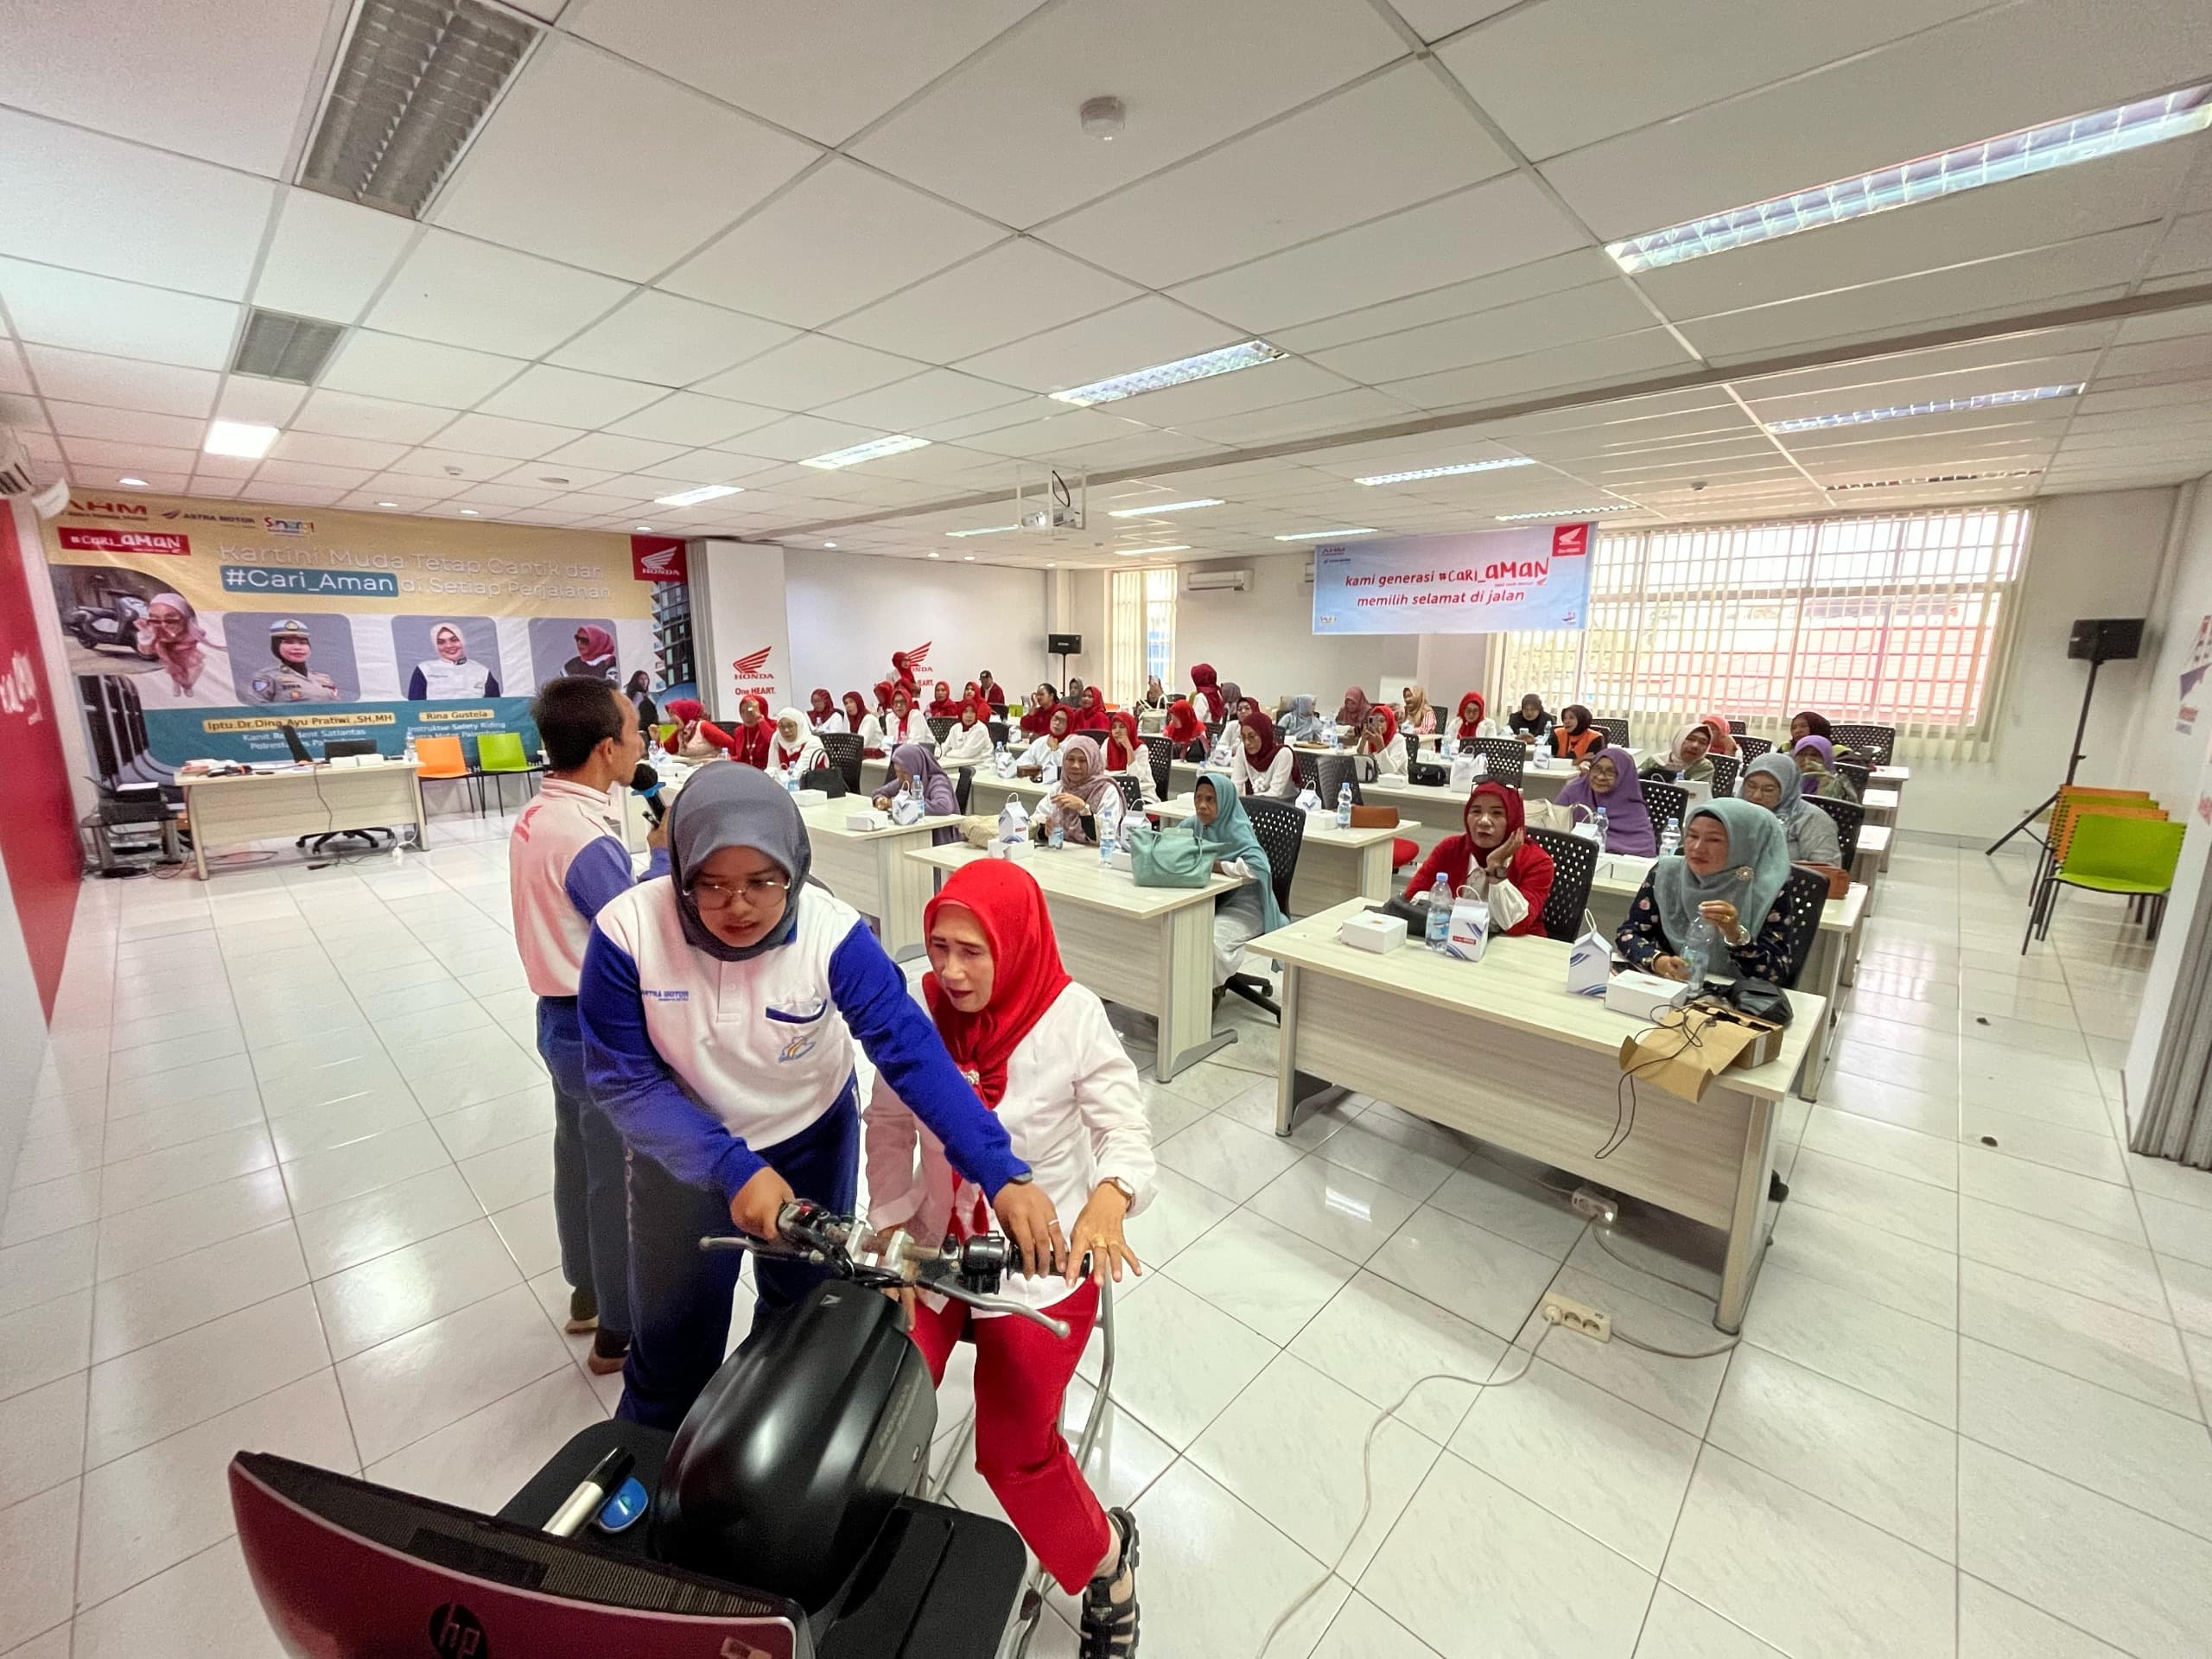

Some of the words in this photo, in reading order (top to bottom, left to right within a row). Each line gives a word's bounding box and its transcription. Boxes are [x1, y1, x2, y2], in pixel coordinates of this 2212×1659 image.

[219, 545, 319, 566] Kartini
[330, 549, 405, 569] Muda
[410, 553, 480, 575] Tetap
[487, 557, 560, 576] Cantik
[566, 563, 604, 580] dan
[226, 568, 393, 592] #Cari_Aman
[401, 574, 423, 594] di
[429, 577, 501, 599] Setiap
[508, 581, 610, 601] Perjalanan
[1345, 574, 1375, 587] kami
[1378, 570, 1434, 588] generasi
[1357, 594, 1408, 607] memilih
[1412, 592, 1465, 605] selamat
[1471, 590, 1484, 603] di
[1486, 589, 1524, 606] jalan
[287, 718, 308, 728] Ayu
[312, 715, 350, 725] Pratiwi
